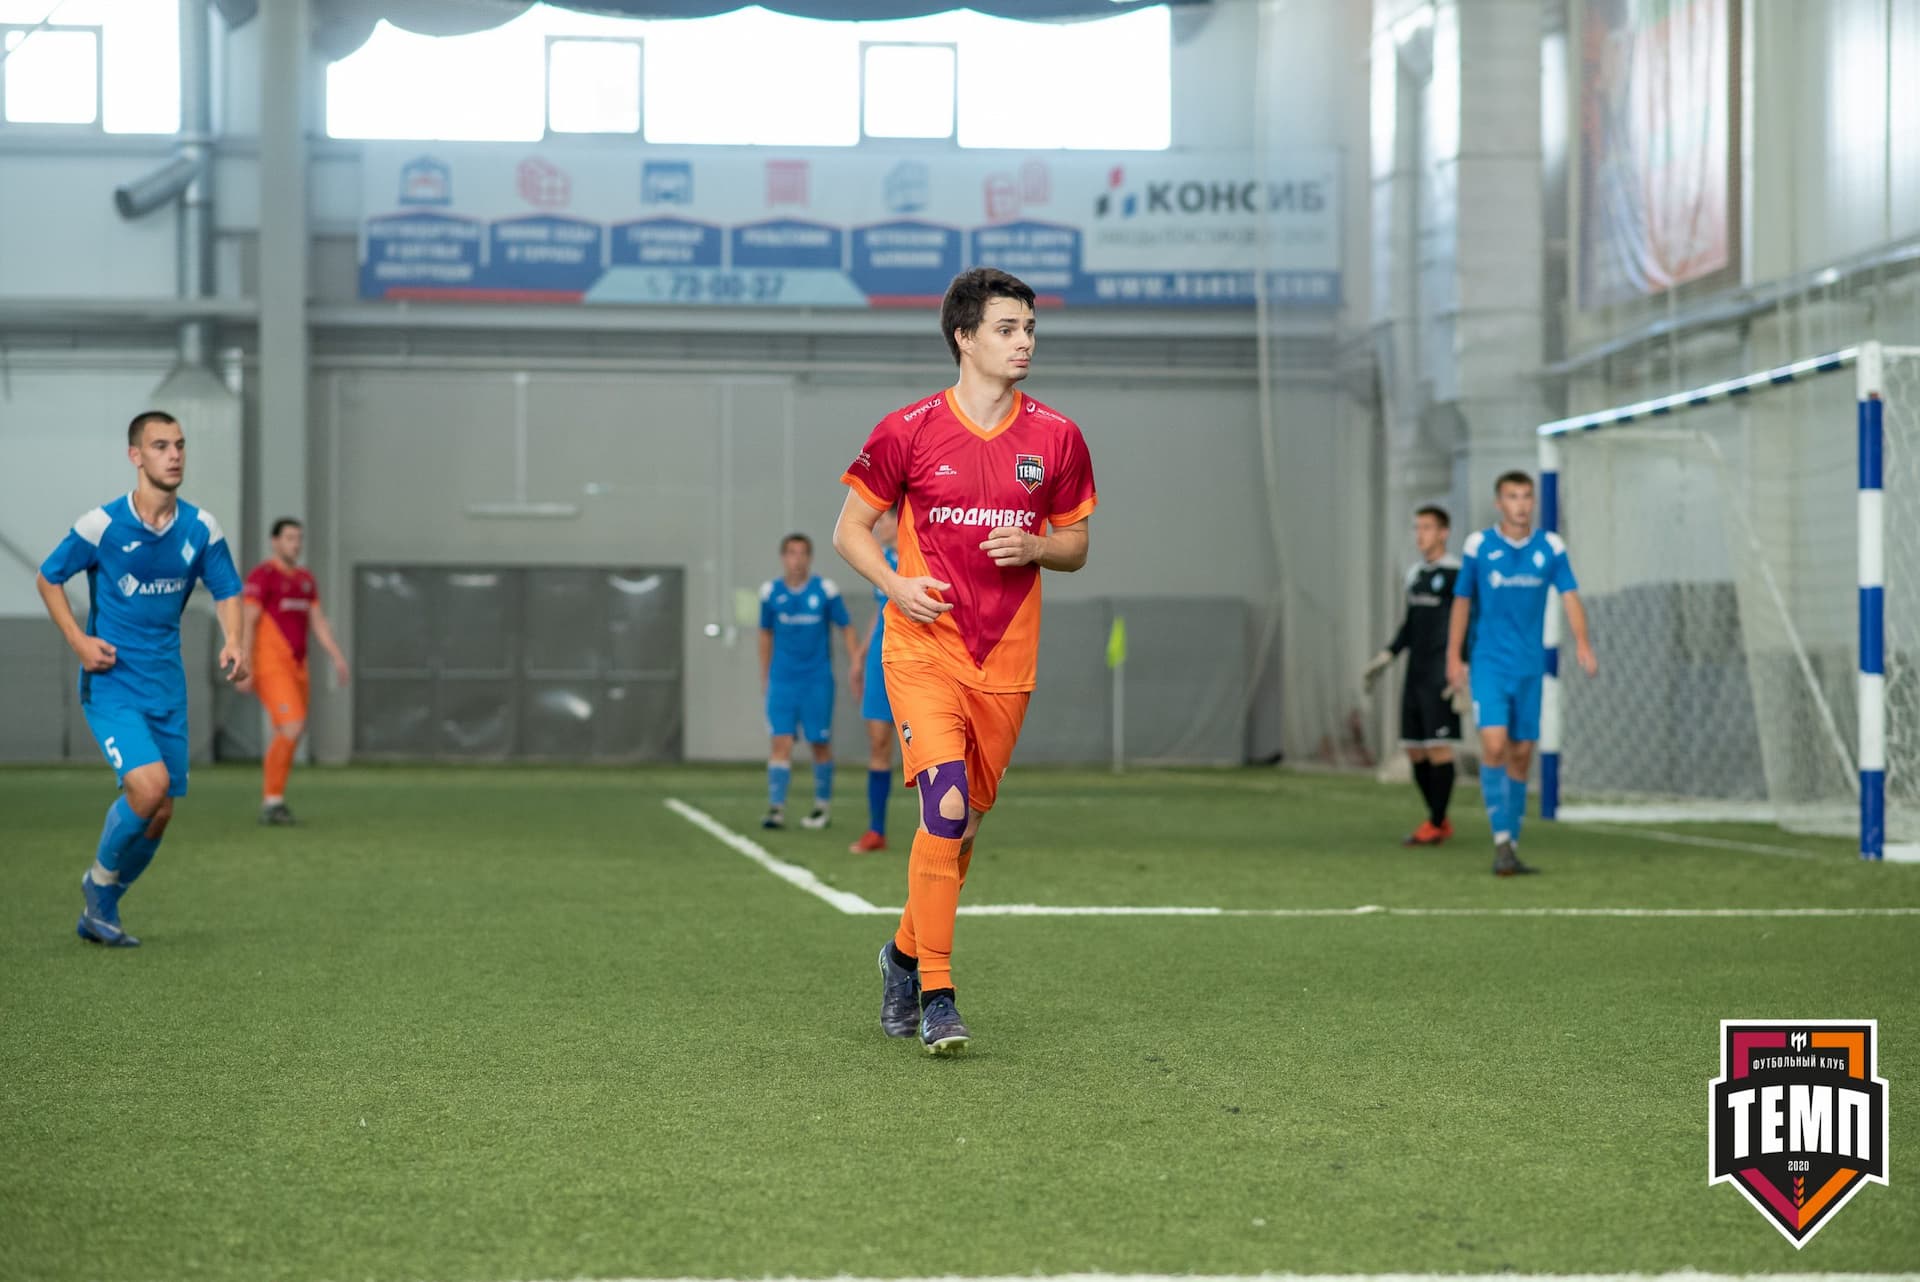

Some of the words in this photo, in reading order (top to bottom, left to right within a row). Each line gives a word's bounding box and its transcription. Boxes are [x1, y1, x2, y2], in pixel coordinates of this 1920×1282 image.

[1147, 181, 1326, 213] КОНСИБ
[1017, 465, 1042, 481] ТЕМП
[104, 736, 123, 769] 5
